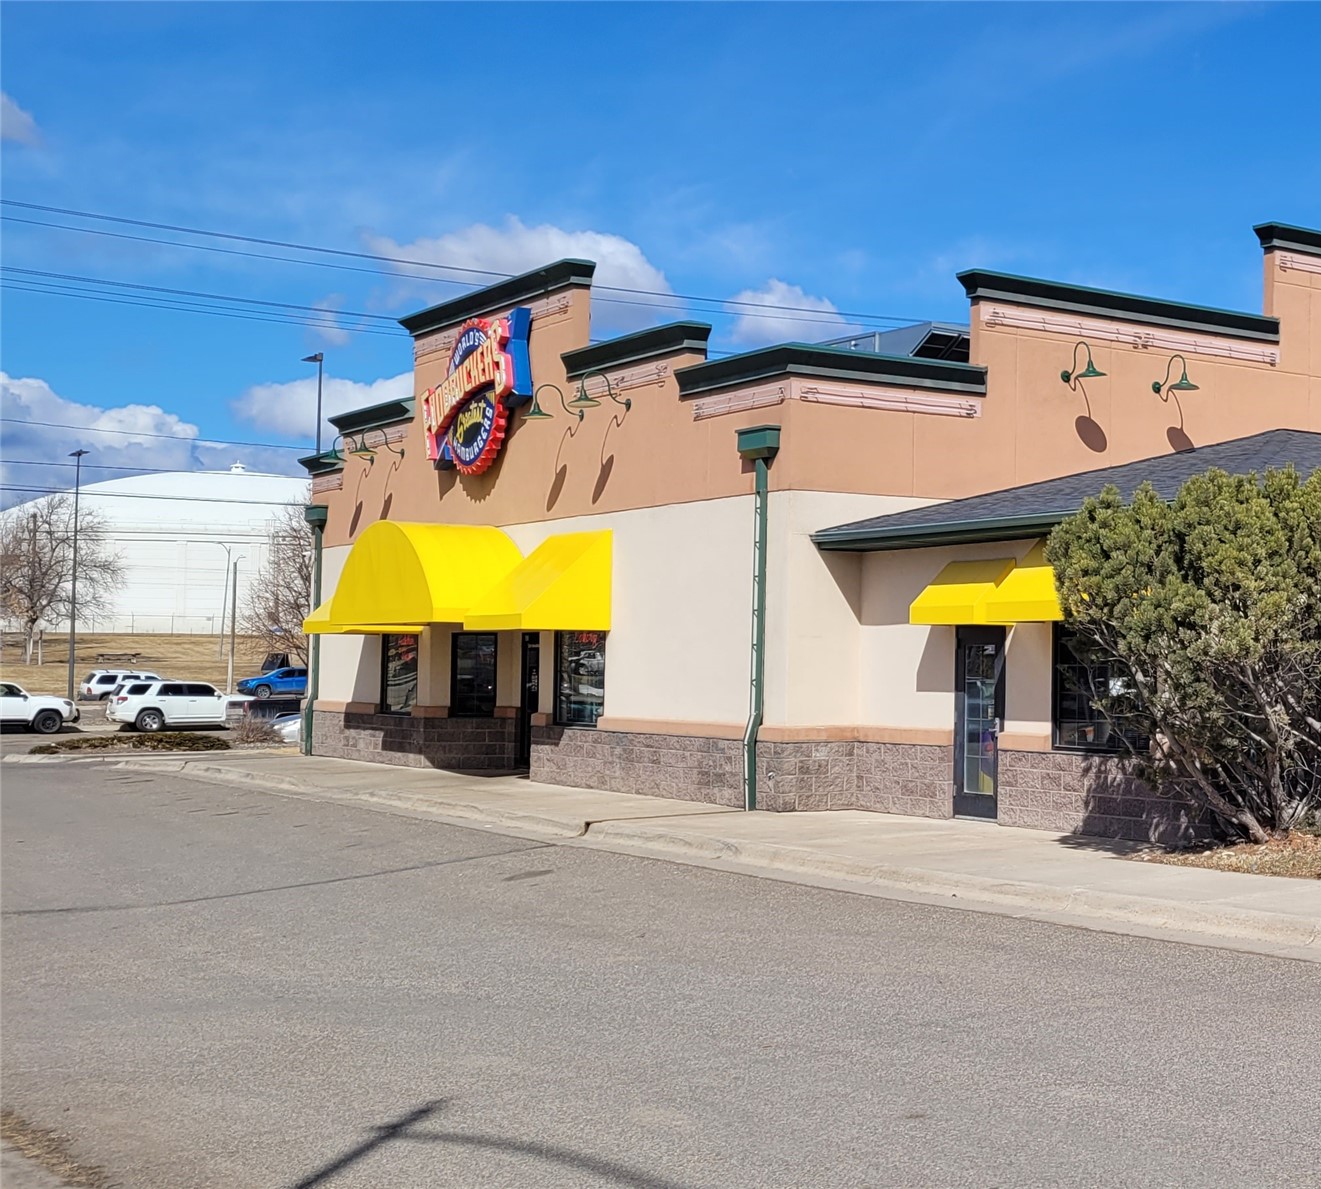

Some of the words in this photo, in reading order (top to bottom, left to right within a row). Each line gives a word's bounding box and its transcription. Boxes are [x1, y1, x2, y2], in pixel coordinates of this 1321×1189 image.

[453, 329, 481, 365] WORLD'S
[421, 319, 506, 460] FUDDRUCKERS
[452, 406, 494, 462] HAMBURGERS
